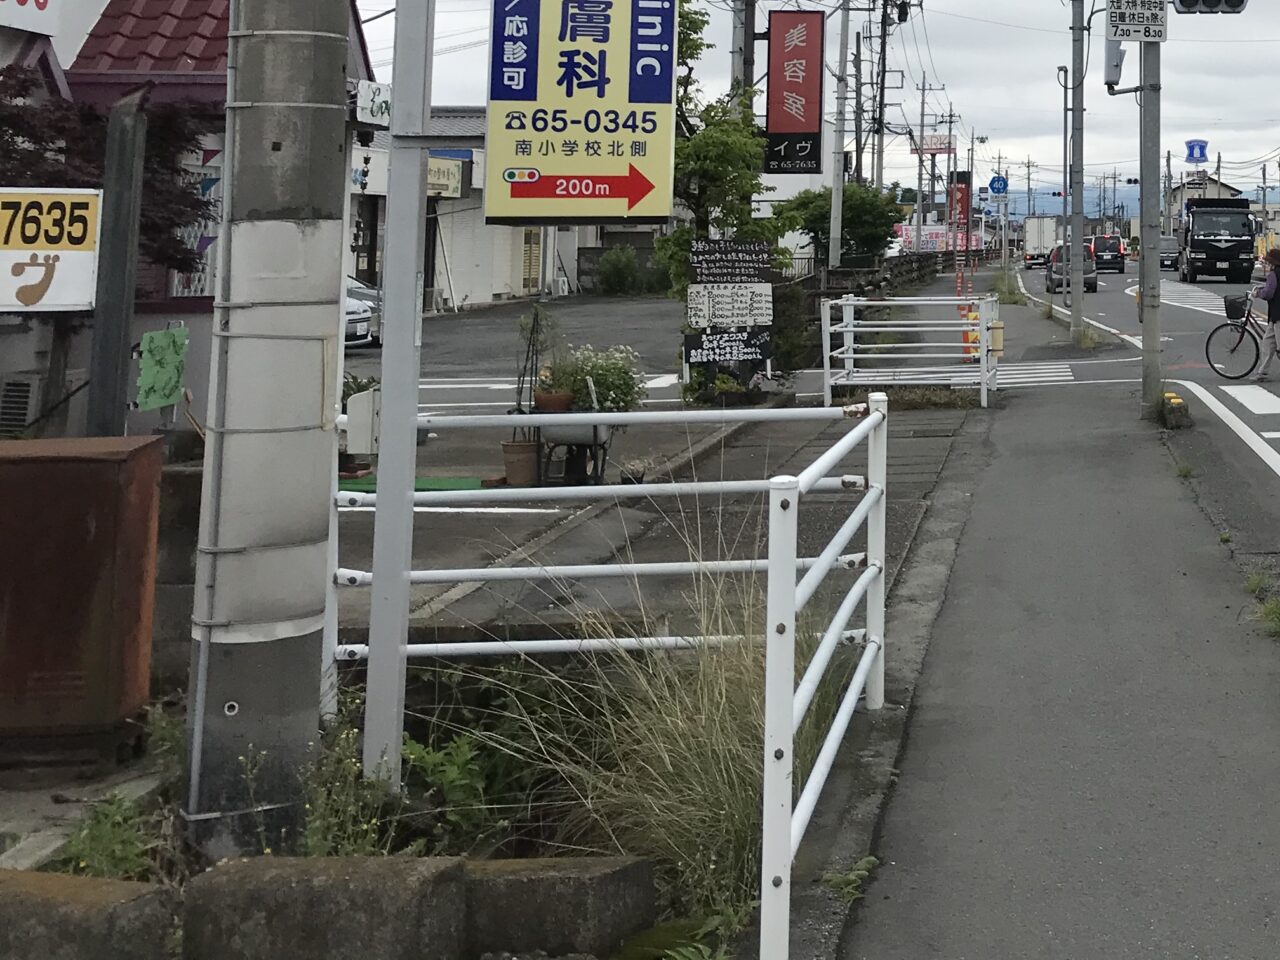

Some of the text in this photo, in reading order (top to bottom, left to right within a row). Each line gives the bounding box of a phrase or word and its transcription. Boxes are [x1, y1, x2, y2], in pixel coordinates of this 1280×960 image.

[1109, 12, 1164, 23] 日曜・休日を除く
[783, 22, 808, 122] 美容室
[531, 108, 657, 134] 65-0345
[515, 139, 647, 157] 南小学校北側
[774, 140, 813, 156] イヴ
[780, 160, 817, 169] 65-7635
[555, 179, 610, 195] 200m
[0, 200, 90, 246] 7635
